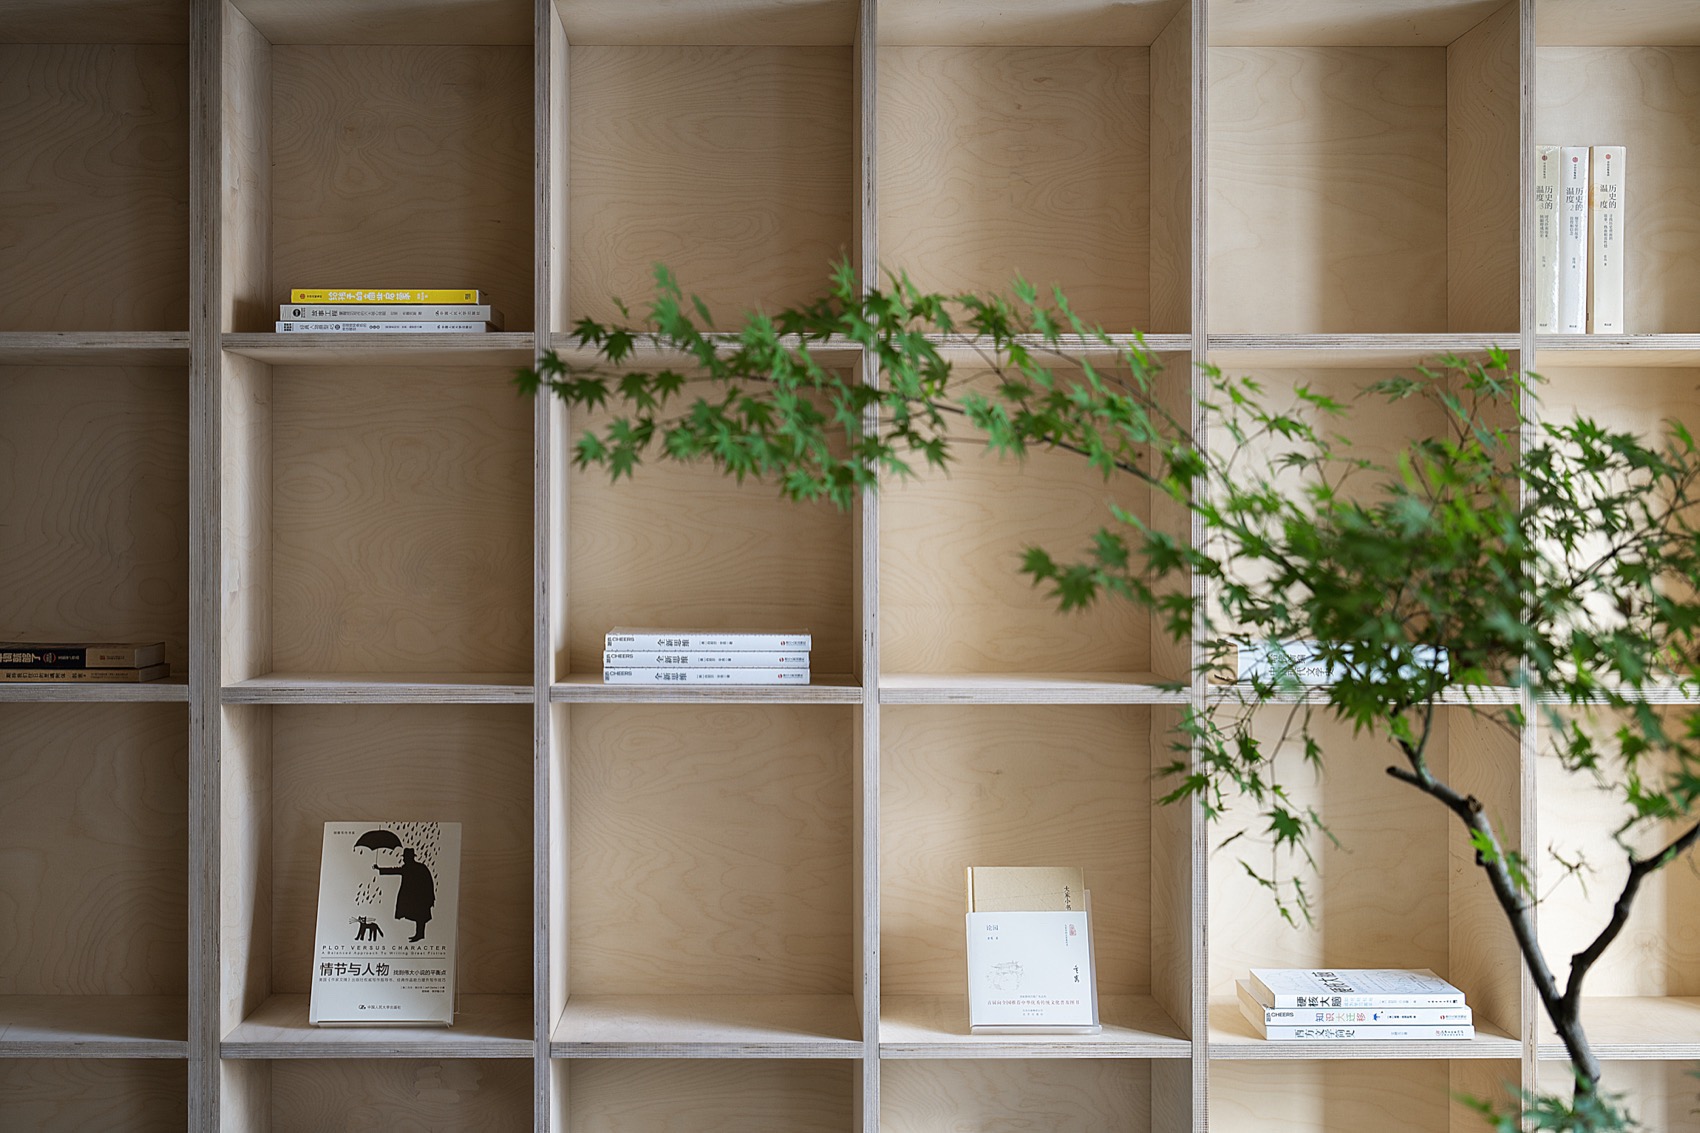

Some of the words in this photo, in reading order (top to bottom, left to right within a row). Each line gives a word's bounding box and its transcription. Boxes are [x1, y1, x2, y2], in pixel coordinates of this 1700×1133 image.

[1608, 184, 1617, 209] 历史的
[657, 639, 690, 647] 全新思维
[656, 655, 688, 664] 全新思维
[655, 672, 687, 681] 全新思维
[319, 962, 390, 976] 情节与人物
[1296, 996, 1342, 1007] 硬核大脑
[1315, 1012, 1366, 1022] 知识大迁移
